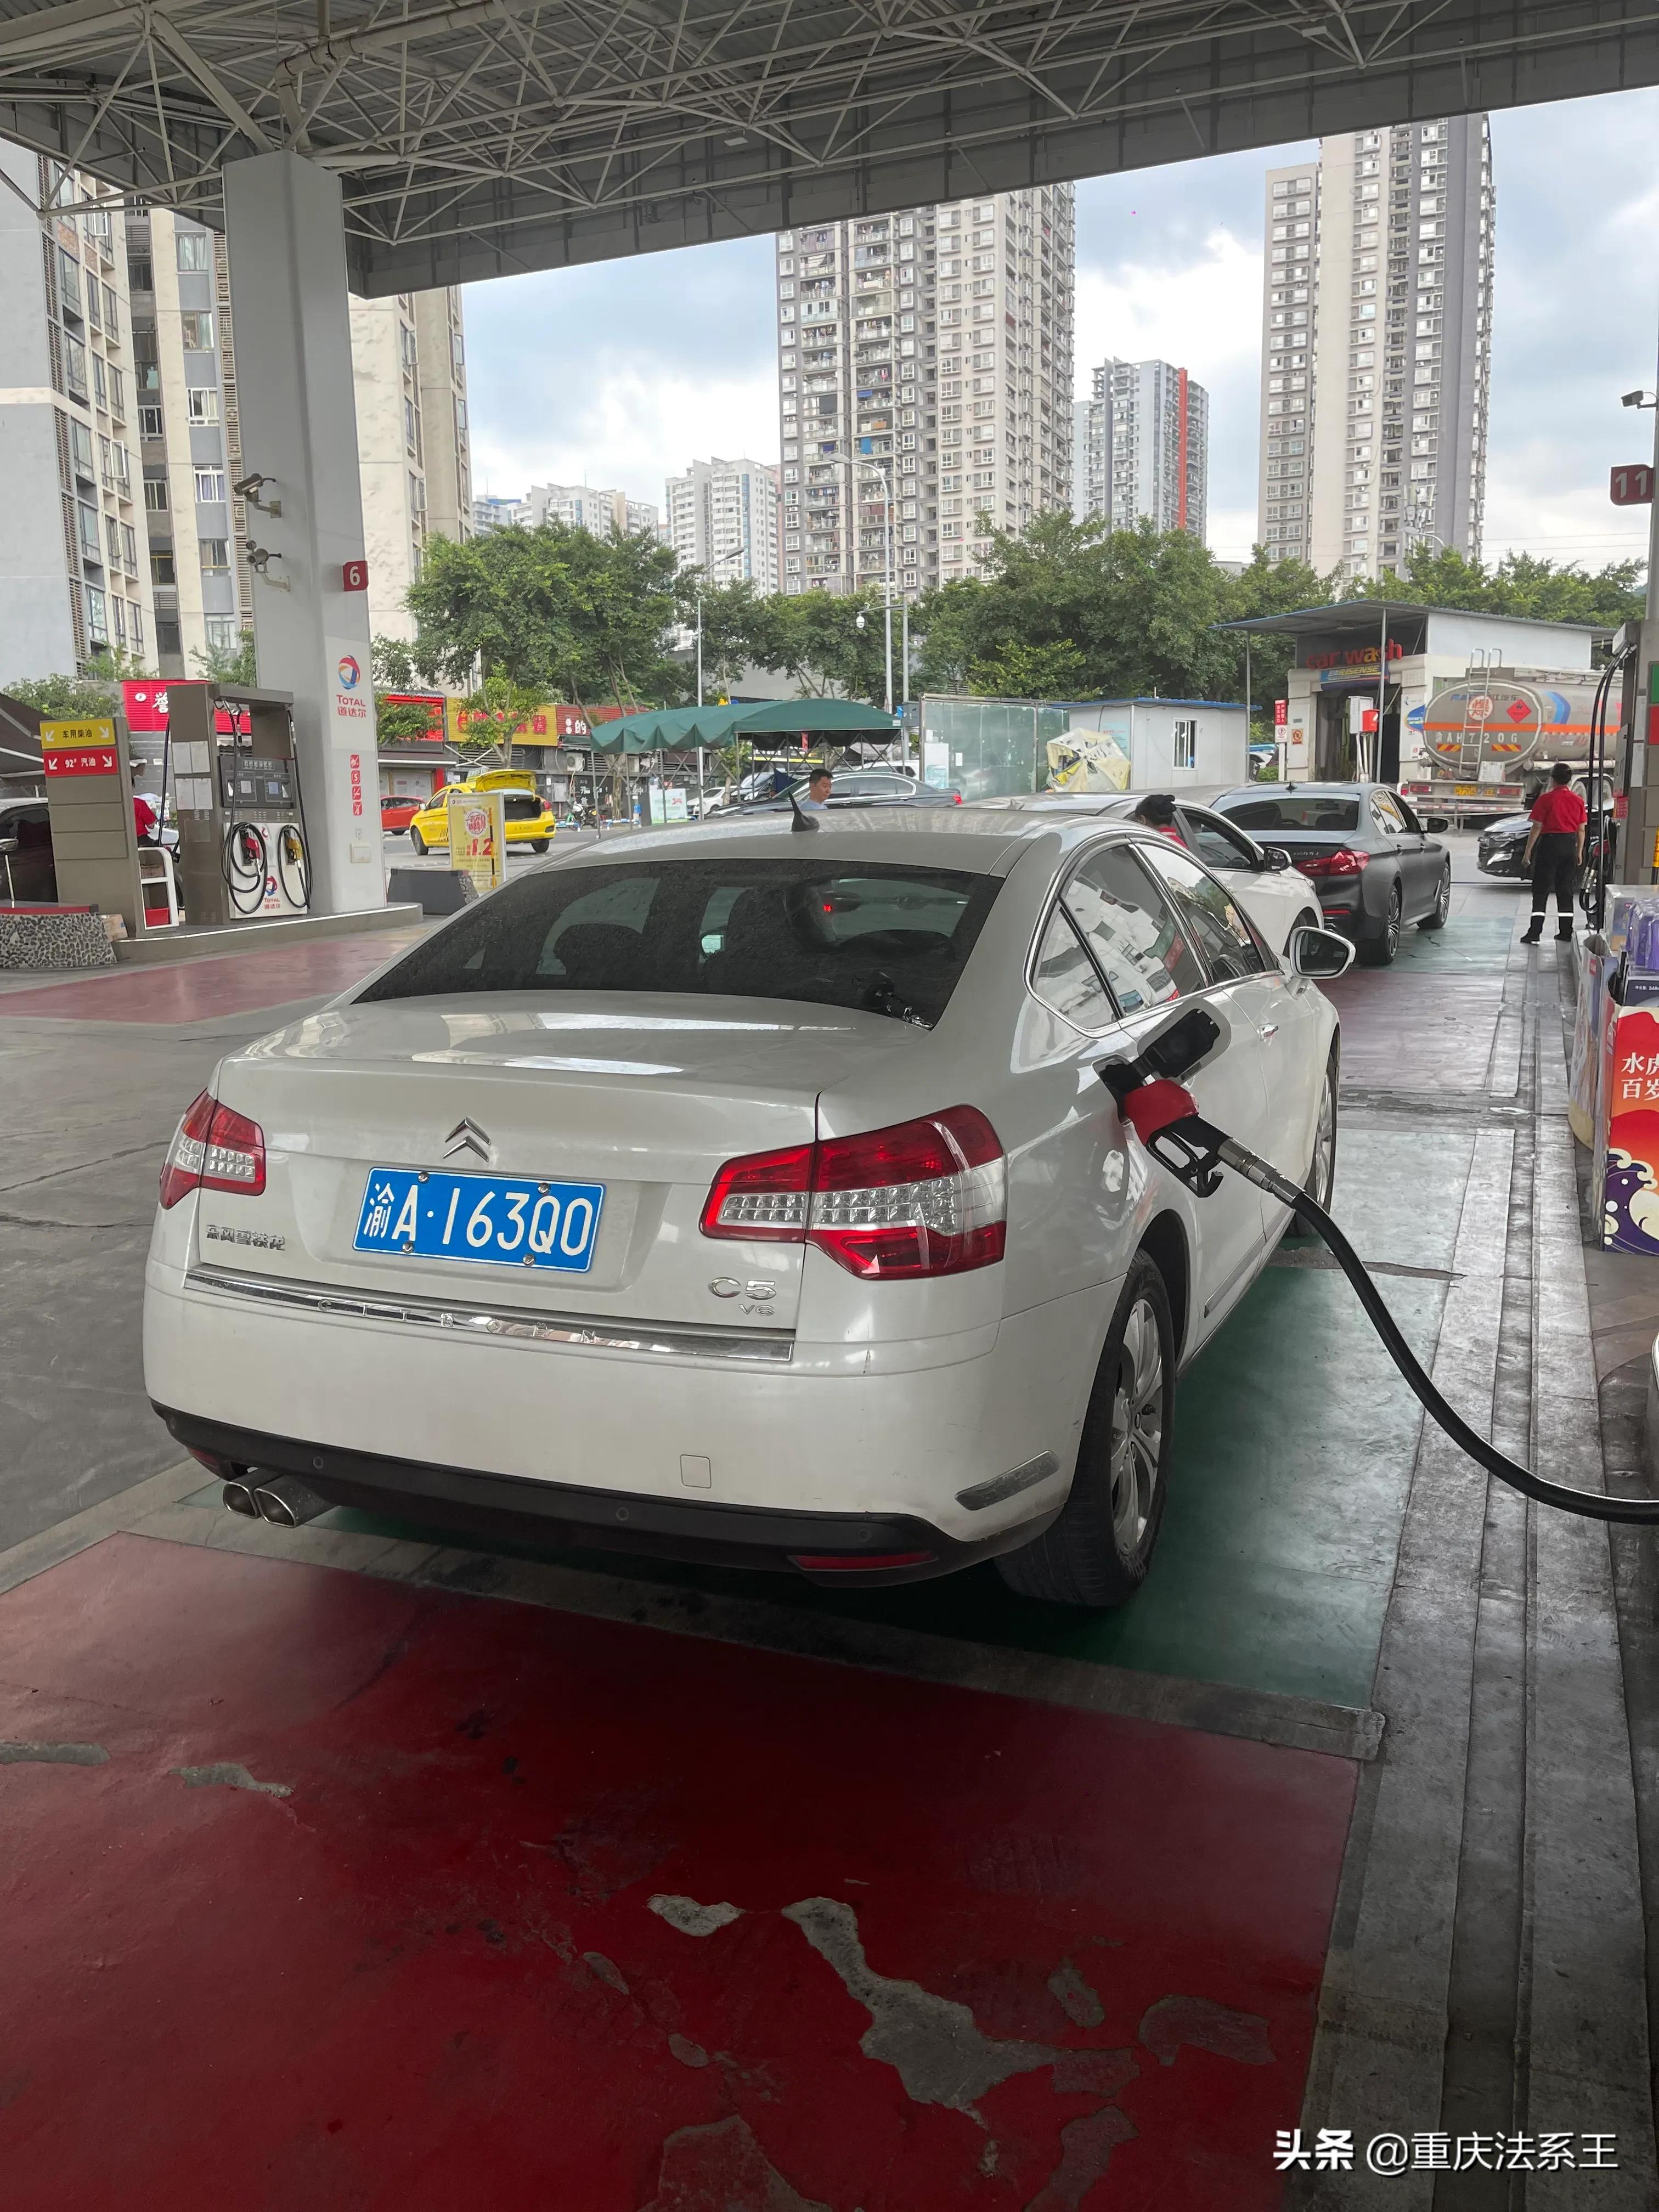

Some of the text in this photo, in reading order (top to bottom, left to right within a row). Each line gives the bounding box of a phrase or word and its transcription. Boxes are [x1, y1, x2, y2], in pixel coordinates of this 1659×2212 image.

[1615, 470, 1647, 498] 11
[349, 566, 360, 586] 6
[1305, 650, 1341, 670] car
[336, 695, 366, 707] TOTAL
[337, 707, 366, 718] 道达尔
[62, 729, 92, 739] 车用柴油
[574, 720, 587, 735] 的
[81, 757, 96, 767] 汽油
[1621, 1077, 1659, 1101] 百岁
[707, 1277, 777, 1301] C5
[738, 1304, 775, 1317] V6
